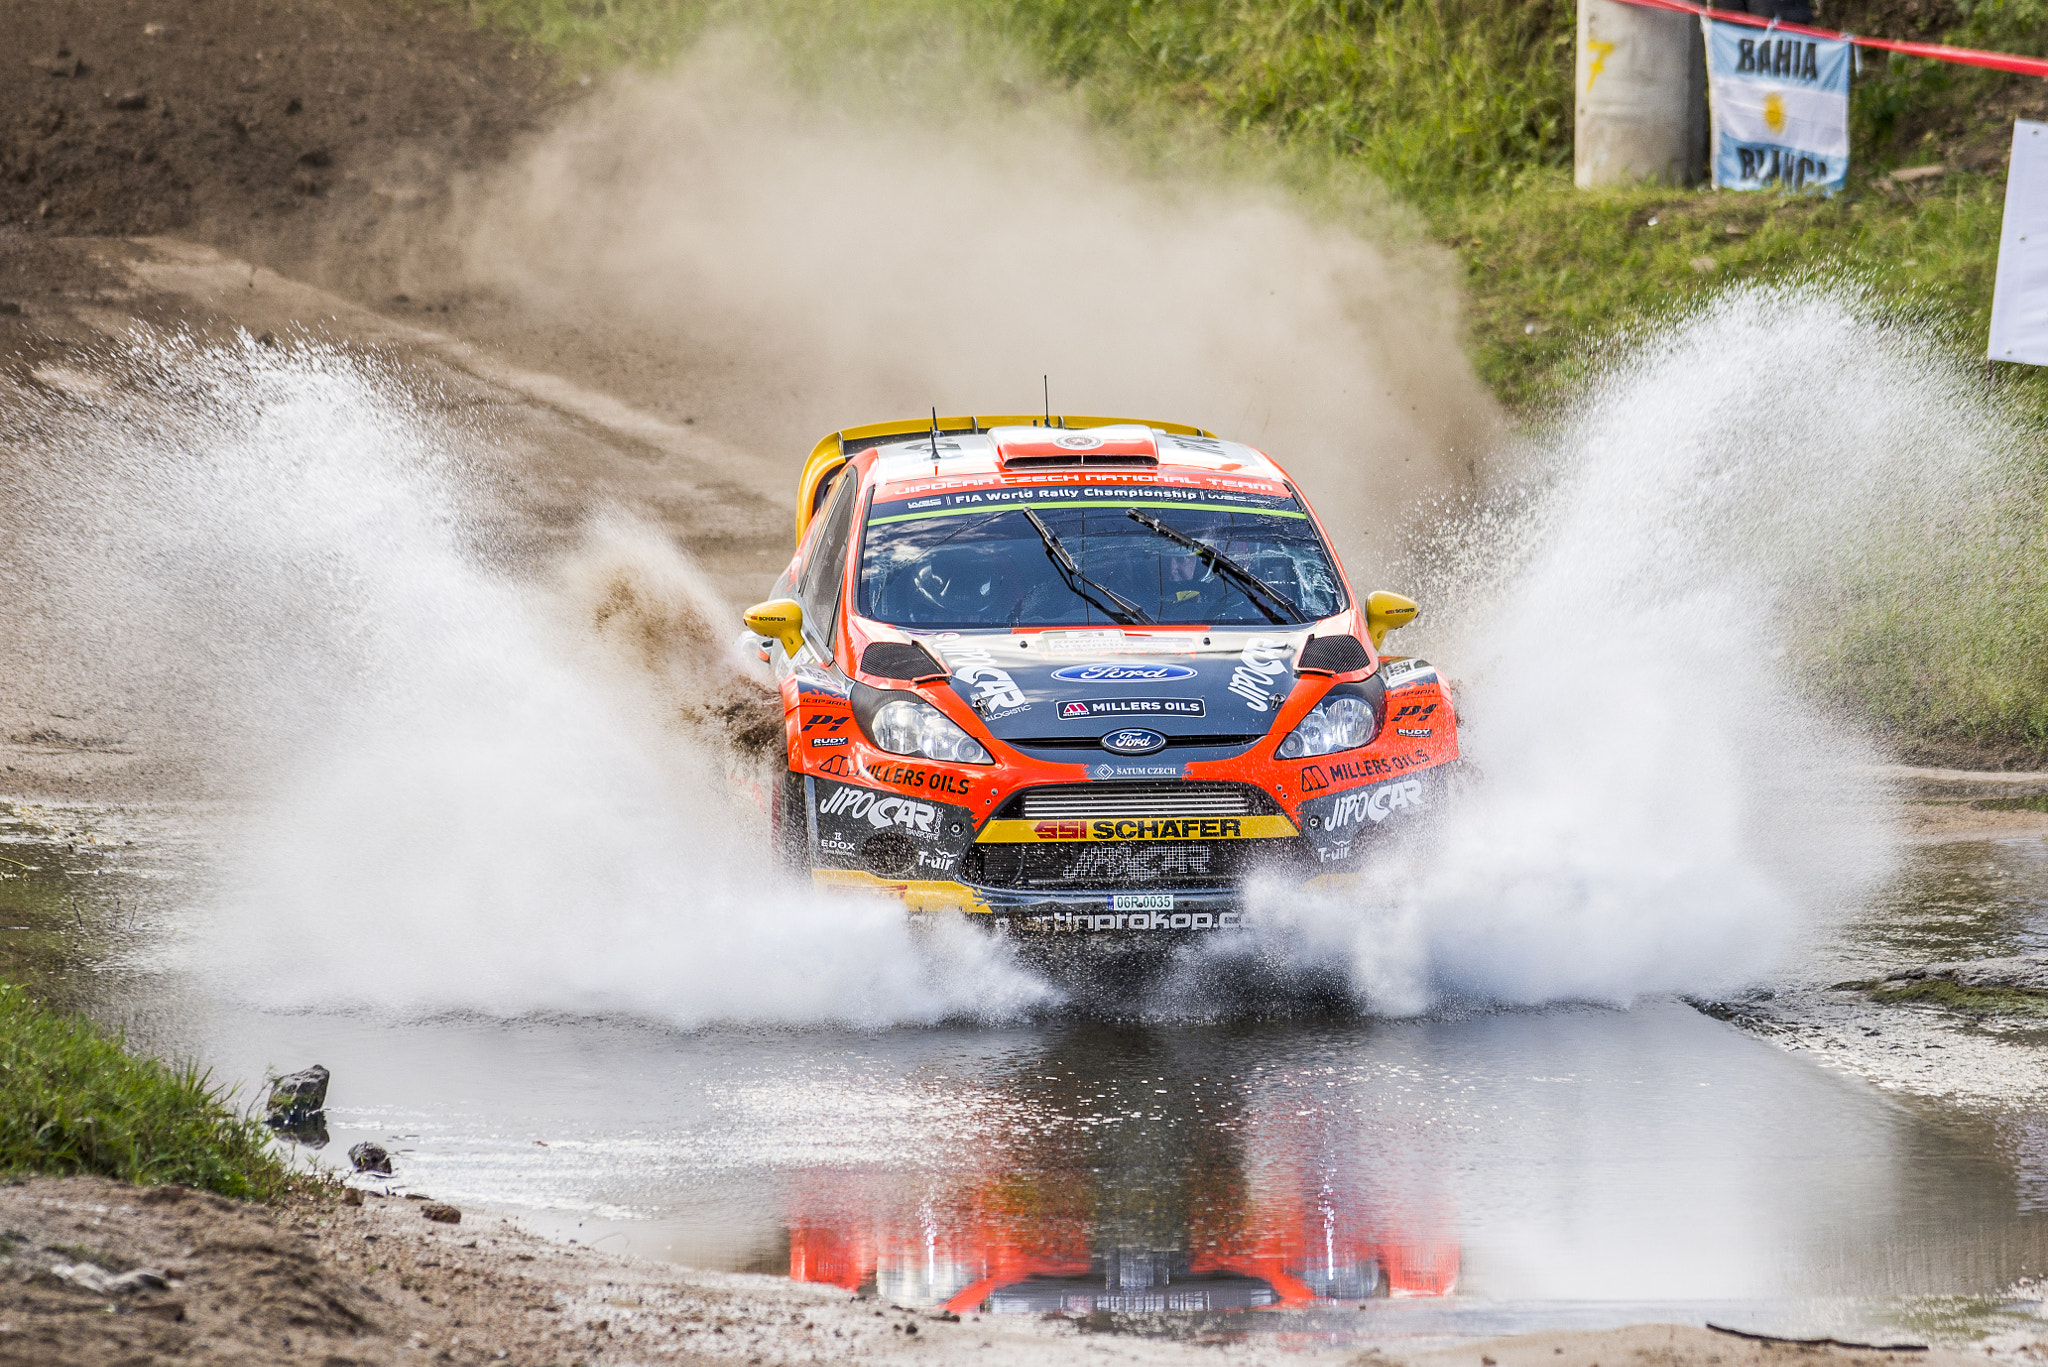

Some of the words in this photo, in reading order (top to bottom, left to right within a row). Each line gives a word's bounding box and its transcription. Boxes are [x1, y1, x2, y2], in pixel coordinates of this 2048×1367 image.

[1735, 38, 1818, 80] BAHIA
[894, 478, 995, 495] JIPOCAR
[1000, 474, 1080, 484] CZECH
[1085, 474, 1200, 484] NATIONAL
[1206, 478, 1273, 491] TEAM
[955, 494, 983, 504] FIA
[986, 490, 1033, 500] World
[1039, 489, 1079, 498] Rally
[1084, 488, 1197, 500] Championship
[1080, 664, 1169, 679] Ford
[1092, 701, 1161, 712] MILLERS
[1164, 701, 1200, 712] OILS
[813, 737, 847, 745] RUDY
[1115, 732, 1151, 747] Ford
[1147, 767, 1177, 775] CZECH
[1329, 758, 1392, 782] MILLERS
[1391, 749, 1430, 770] OILS
[855, 764, 925, 787] MILLERS
[929, 773, 970, 796] OILS
[1034, 820, 1087, 839] SSI
[1092, 818, 1242, 840] SCHÄFER
[821, 839, 856, 851] EDOX
[918, 850, 955, 871] T-air
[1117, 896, 1140, 908] 06R
[1143, 896, 1171, 908] 0035
[996, 910, 1252, 933] artinprokop.c
